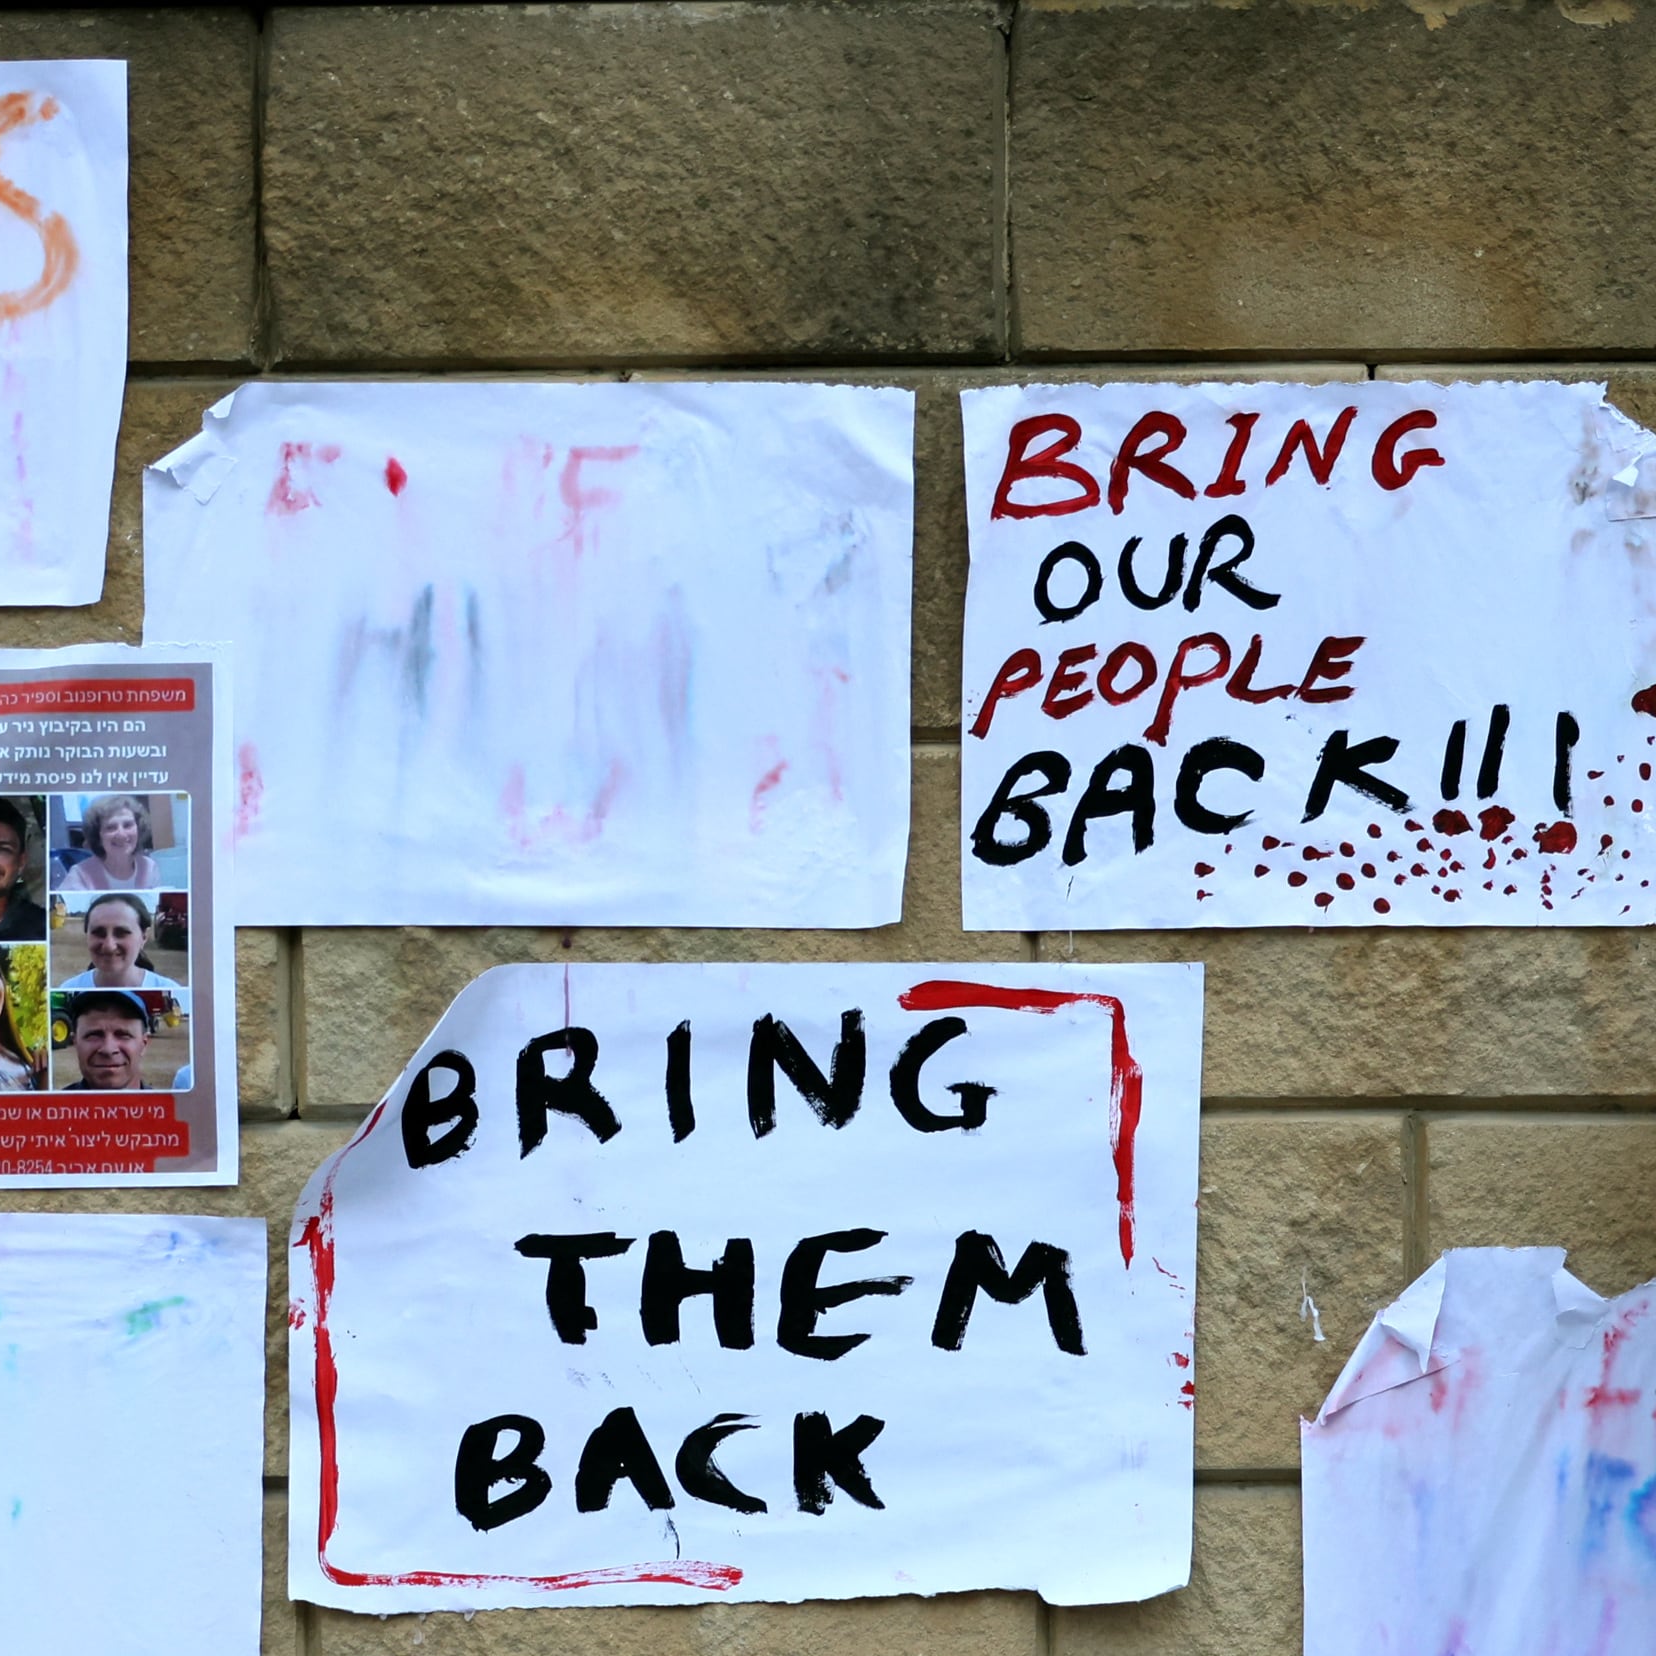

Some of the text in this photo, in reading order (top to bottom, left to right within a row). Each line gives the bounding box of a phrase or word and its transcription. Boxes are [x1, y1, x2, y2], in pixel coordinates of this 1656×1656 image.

[990, 406, 1445, 521] BRING
[1033, 513, 1281, 625] OUR
[968, 632, 1367, 747] PEOPLE
[12, 721, 34, 733] ניר
[38, 720, 93, 736] בקיבוץ
[97, 720, 118, 732] היו
[123, 720, 146, 732] הם
[14, 746, 50, 762] נותק
[55, 746, 104, 762] הבוקר
[108, 745, 167, 759] ובשעות
[35, 772, 76, 784] פיסת
[81, 768, 102, 784] לנו
[107, 772, 128, 787] אין
[133, 771, 168, 787] עדיין
[401, 1008, 999, 1170] BRING
[26, 1107, 42, 1120] או
[46, 1107, 89, 1120] אותם
[94, 1106, 144, 1119] שראה
[148, 1106, 165, 1119] מי
[30, 1135, 66, 1148] איתי
[70, 1130, 111, 1147] ליצור
[115, 1132, 180, 1147] מתבקש
[514, 1227, 1088, 1362] THEM
[454, 1406, 887, 1532] BACK
